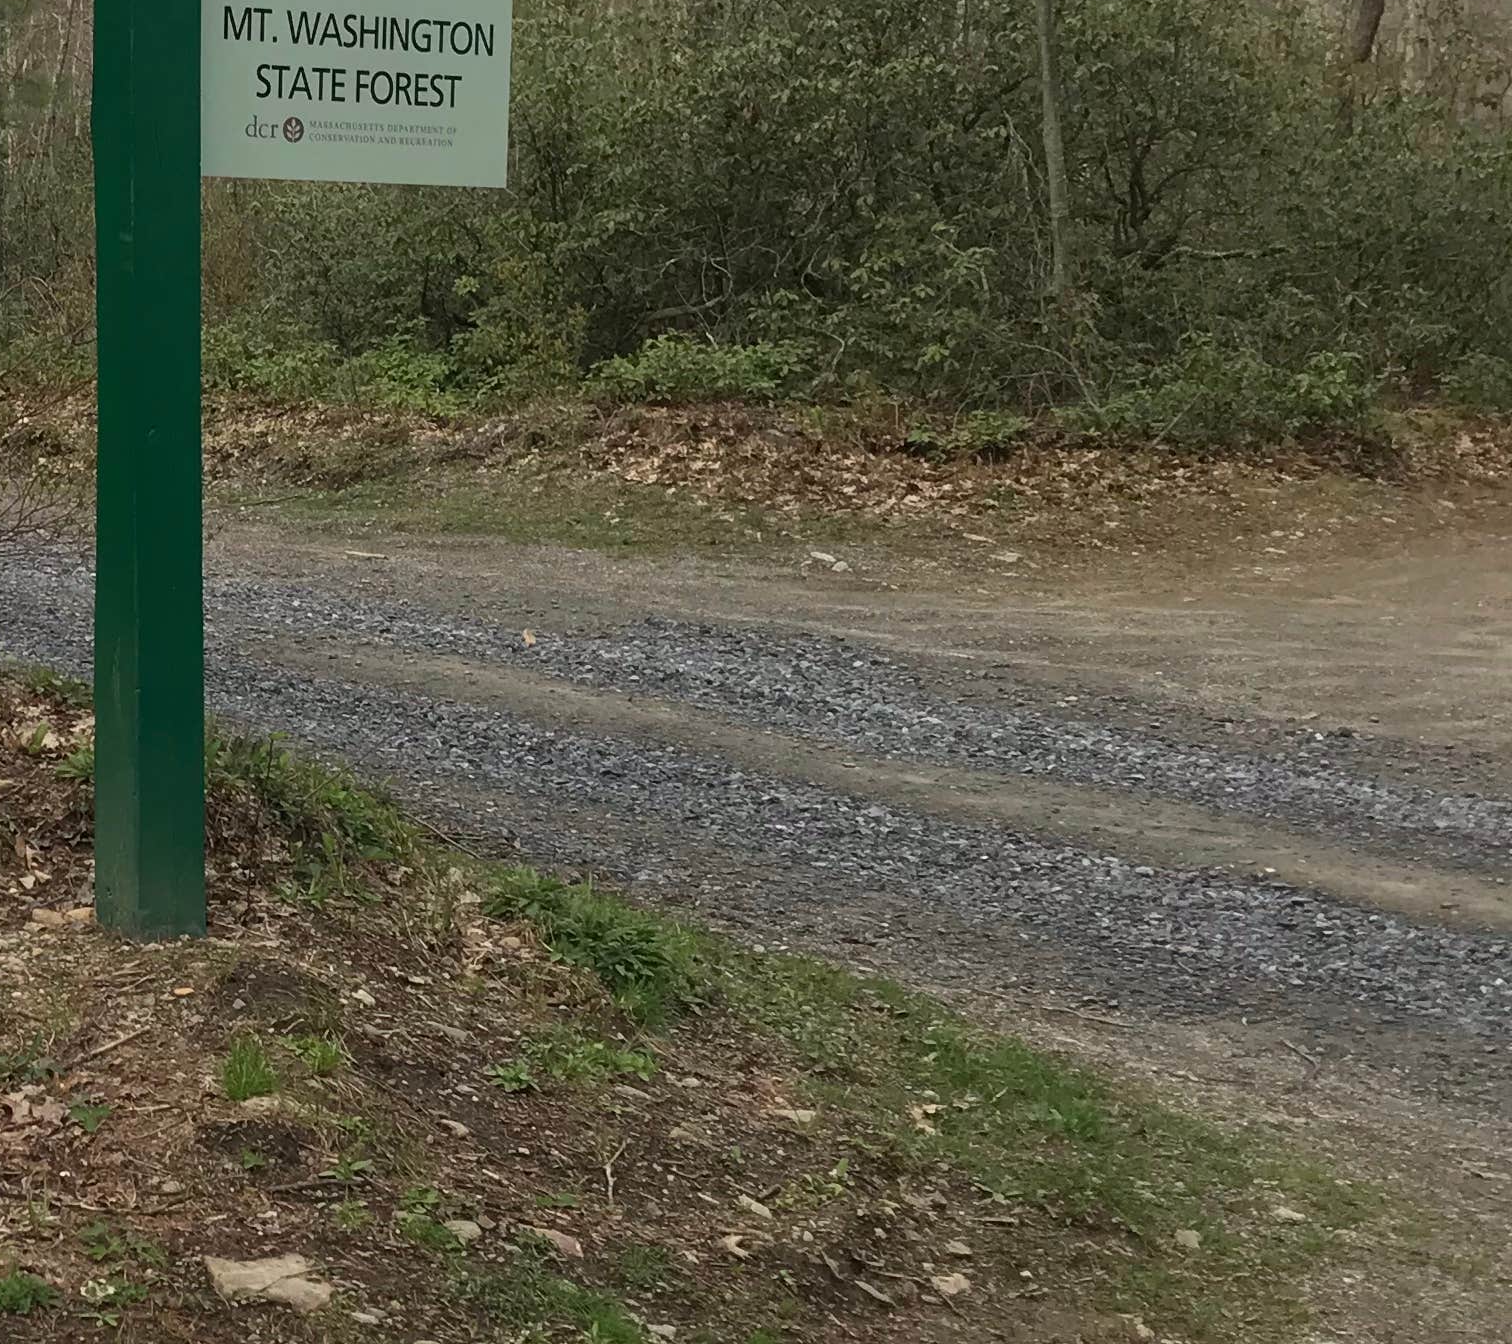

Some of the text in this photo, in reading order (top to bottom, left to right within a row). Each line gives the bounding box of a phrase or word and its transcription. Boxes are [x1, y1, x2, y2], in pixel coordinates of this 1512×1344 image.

[223, 6, 495, 57] MT. WASHINGTON
[256, 64, 463, 108] STATE FOREST
[245, 115, 279, 139] dcr
[309, 120, 385, 132] MASSACHUSETTS
